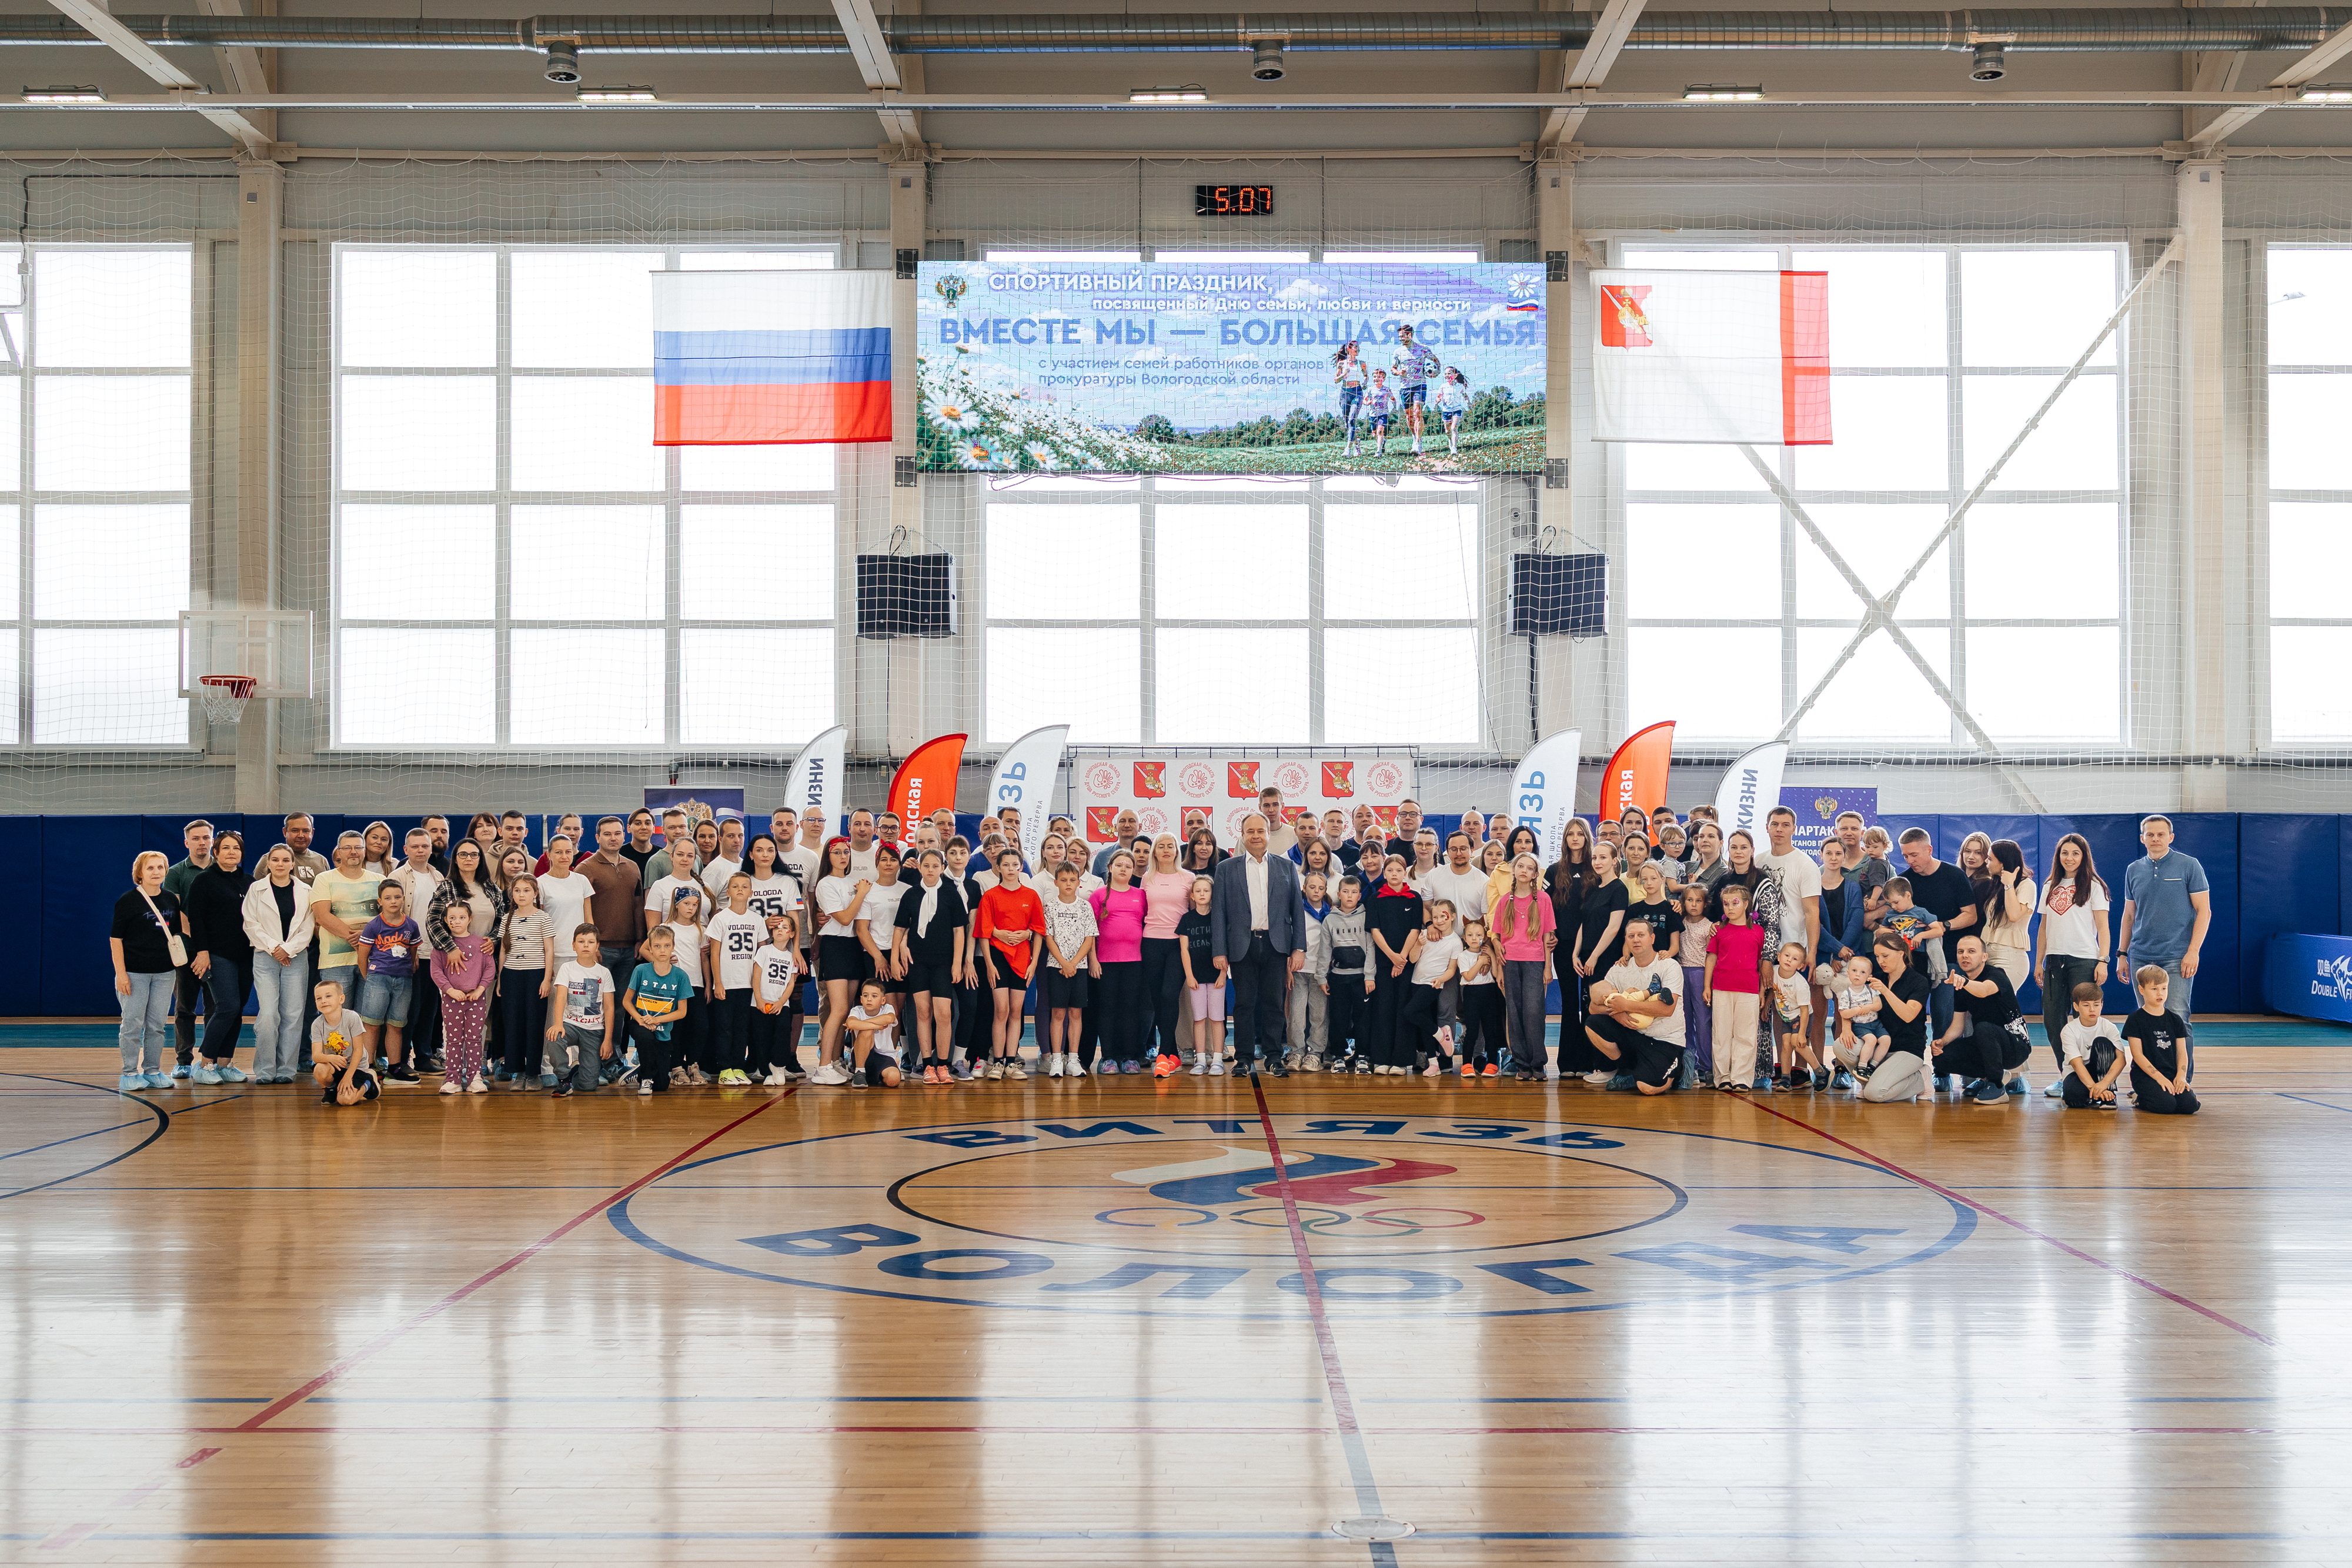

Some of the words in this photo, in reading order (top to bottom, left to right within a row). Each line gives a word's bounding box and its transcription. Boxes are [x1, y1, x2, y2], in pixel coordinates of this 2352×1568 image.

[988, 269, 1143, 291] СПОРТИВНЫЙ
[1151, 275, 1274, 295] ПРАЗДНИК,
[1093, 296, 1208, 312] посвященный
[1215, 297, 1251, 312] Дню
[1257, 299, 1311, 313] семьи,
[1317, 296, 1371, 310] любви
[1377, 299, 1387, 310] и
[1392, 299, 1471, 313] верности
[940, 317, 1082, 345] ВМЕСТЕ
[1096, 318, 1155, 345] МЫ
[1220, 319, 1401, 346] БОЛЬШАЯ
[1415, 319, 1536, 346] СЕМЬЯ
[1038, 359, 1046, 369] с
[1052, 359, 1120, 373] участием
[1124, 356, 1169, 369] семей
[1174, 357, 1258, 372] работников
[1264, 359, 1324, 372] органов
[1038, 375, 1136, 386] прокуратуры
[1141, 372, 1235, 385] Вологодской
[1241, 373, 1299, 385] области
[807, 758, 824, 807] ИЗНИ
[905, 778, 923, 843] одская
[1033, 800, 1043, 833] РЕЗЕРВА
[1518, 771, 1545, 837] ЯЗЬ
[729, 932, 754, 952] 35
[768, 963, 789, 981] 35
[769, 957, 790, 965] VOLOGDA
[642, 979, 677, 991] STAY
[900, 1118, 1626, 1150] ВИТЯЗЬ
[736, 1223, 1910, 1300] ВОЛОГДА
